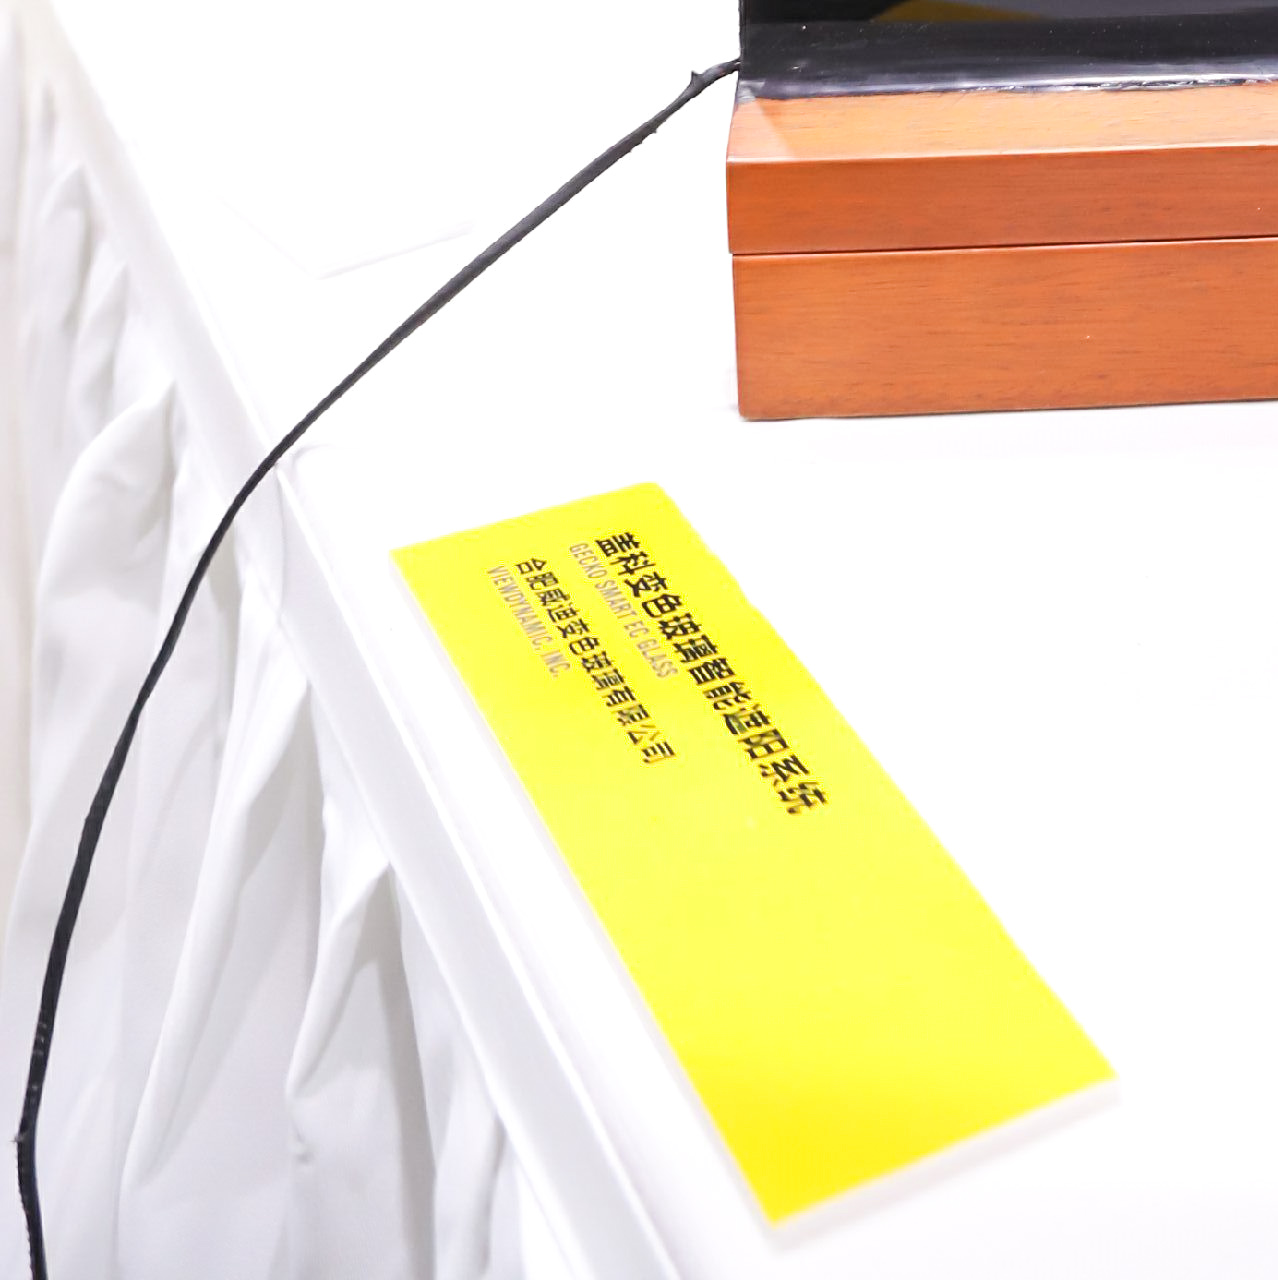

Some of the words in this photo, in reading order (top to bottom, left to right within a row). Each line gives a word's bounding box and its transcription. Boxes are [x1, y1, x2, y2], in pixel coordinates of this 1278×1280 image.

[569, 541, 608, 580] GECKO
[594, 578, 638, 620] SMART
[624, 620, 650, 639] EC
[514, 557, 676, 764] 合肥威迪变色玻璃有限公司
[595, 531, 828, 815] 盖科变色玻璃智能遮阳系统
[636, 638, 679, 678] GLASS
